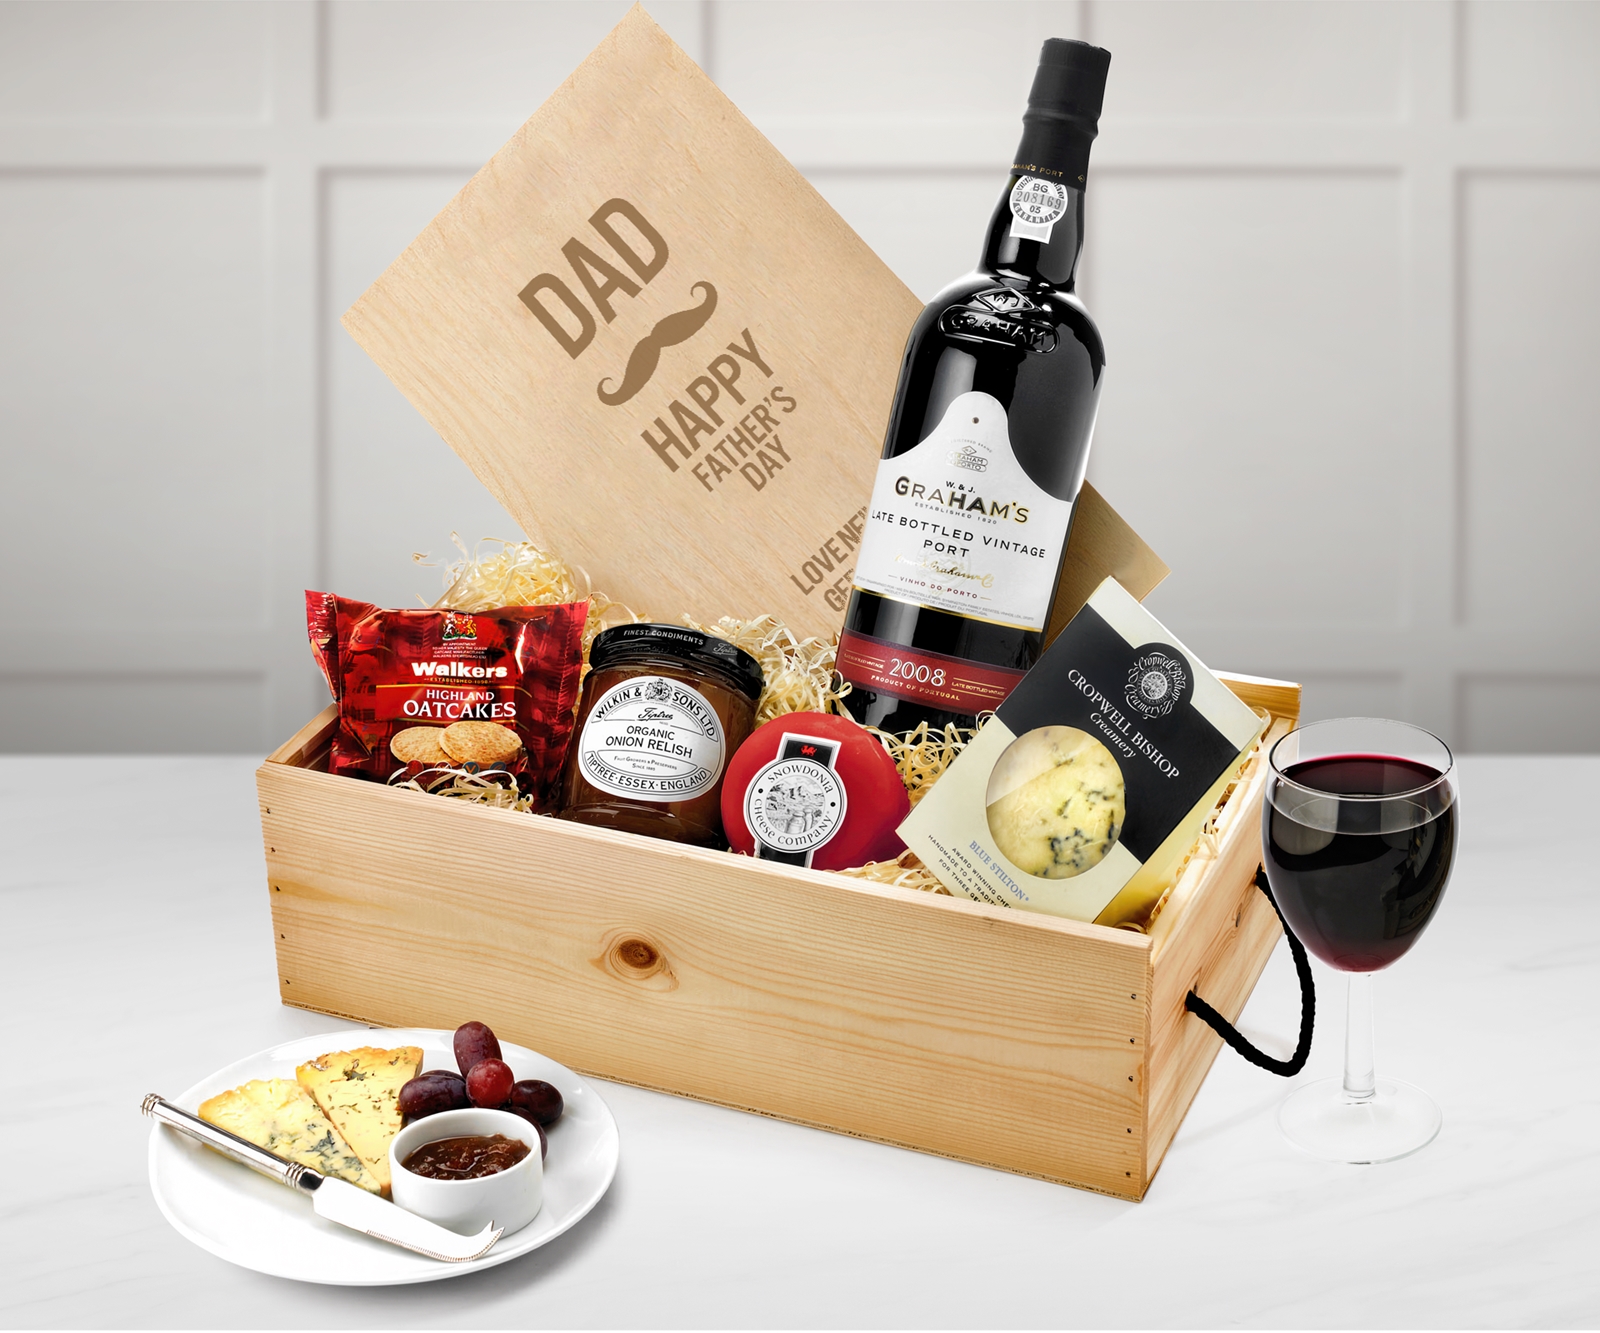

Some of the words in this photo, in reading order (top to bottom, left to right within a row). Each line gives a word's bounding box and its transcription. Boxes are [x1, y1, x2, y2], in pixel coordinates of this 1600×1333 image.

[1039, 167, 1064, 178] PORT
[1016, 190, 1062, 210] 208169
[1033, 183, 1048, 194] BG
[1030, 205, 1041, 214] 05
[517, 198, 669, 360] DAD
[640, 328, 774, 472] HAPPY
[691, 386, 797, 492] FATHER'S
[739, 434, 792, 492] DAY
[946, 480, 956, 488] W.
[895, 476, 1030, 524] GRAHAM'S
[915, 502, 972, 519] ESTABLISHED
[978, 516, 997, 525] 1820
[872, 510, 894, 524] LATE
[900, 517, 974, 542] BOTTLED
[982, 536, 1046, 558] VINTAGE
[924, 540, 970, 558] PORT
[790, 537, 849, 596] LOVE
[900, 576, 926, 587] VINHO
[946, 588, 978, 599] PORTO
[652, 630, 703, 645] CONDIMENTS
[412, 662, 508, 678] Walkers
[888, 658, 947, 686] 2008
[426, 690, 495, 701] HIGHLAND
[871, 674, 904, 687] PRODUCT
[919, 687, 960, 700] PORTUGAL
[403, 700, 516, 719] OATCAKES
[596, 688, 630, 719] WILKIN
[634, 687, 642, 697] &
[673, 691, 703, 716] SONS
[700, 714, 715, 736] LTD
[638, 707, 673, 721] Tiptree
[626, 725, 675, 740] ORGANIC
[1068, 669, 1132, 736] CROPWELL
[1131, 731, 1180, 779] BISHOP
[1090, 712, 1136, 758] Creamery
[606, 736, 644, 747] ONION
[648, 739, 692, 758] RELISH
[586, 753, 617, 782] TIPTREE
[618, 776, 655, 790] ESSEX
[661, 770, 708, 790] ENGLAND
[969, 840, 992, 865] BLUE
[928, 834, 958, 868] HANDMADE
[959, 867, 967, 877] TO
[973, 882, 996, 906] TRADIT
[938, 858, 951, 872] FOR
[951, 872, 970, 893] THREE
[969, 892, 981, 903] GE
[952, 848, 972, 869] AWARD
[972, 868, 996, 895] WINNING
[996, 895, 1012, 908] CHE
